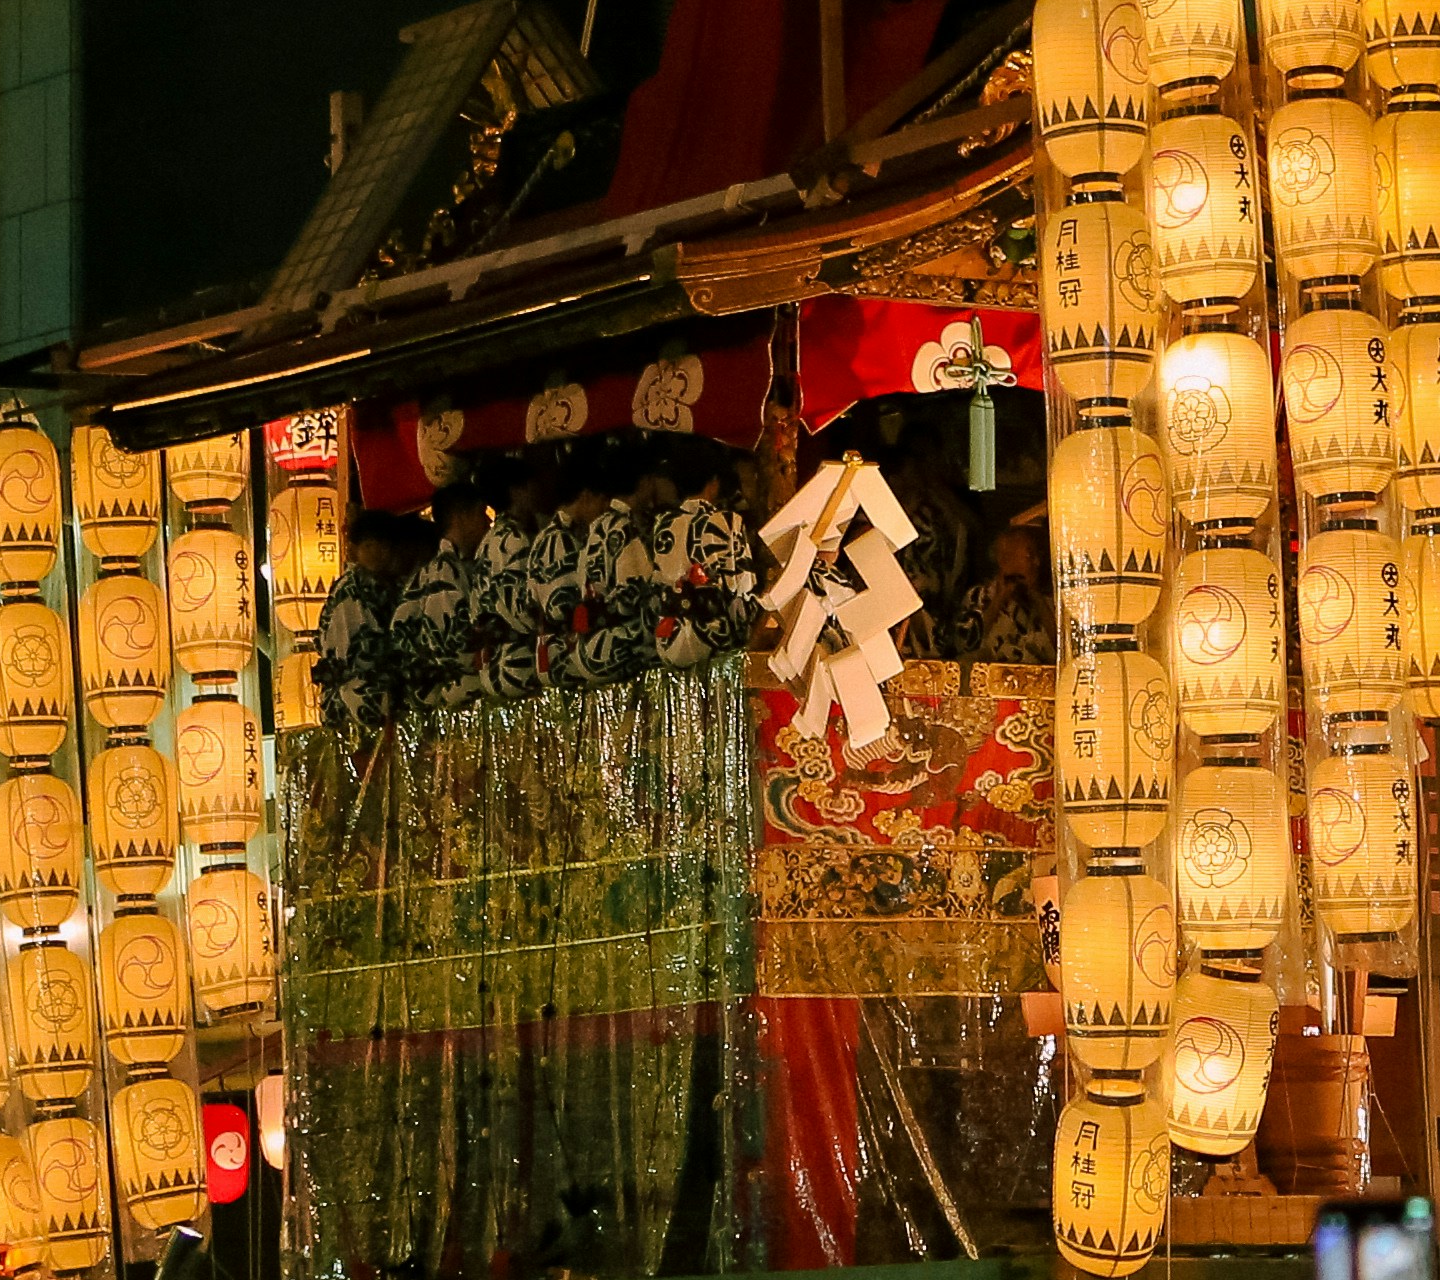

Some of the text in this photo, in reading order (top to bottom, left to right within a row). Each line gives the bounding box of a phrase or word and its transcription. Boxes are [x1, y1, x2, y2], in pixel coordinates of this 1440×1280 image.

[1056, 219, 1082, 308] 月桂冠
[315, 497, 338, 563] 月桂冠
[1071, 668, 1097, 760] 月桂冠
[1070, 1121, 1099, 1210] 月桂冠
